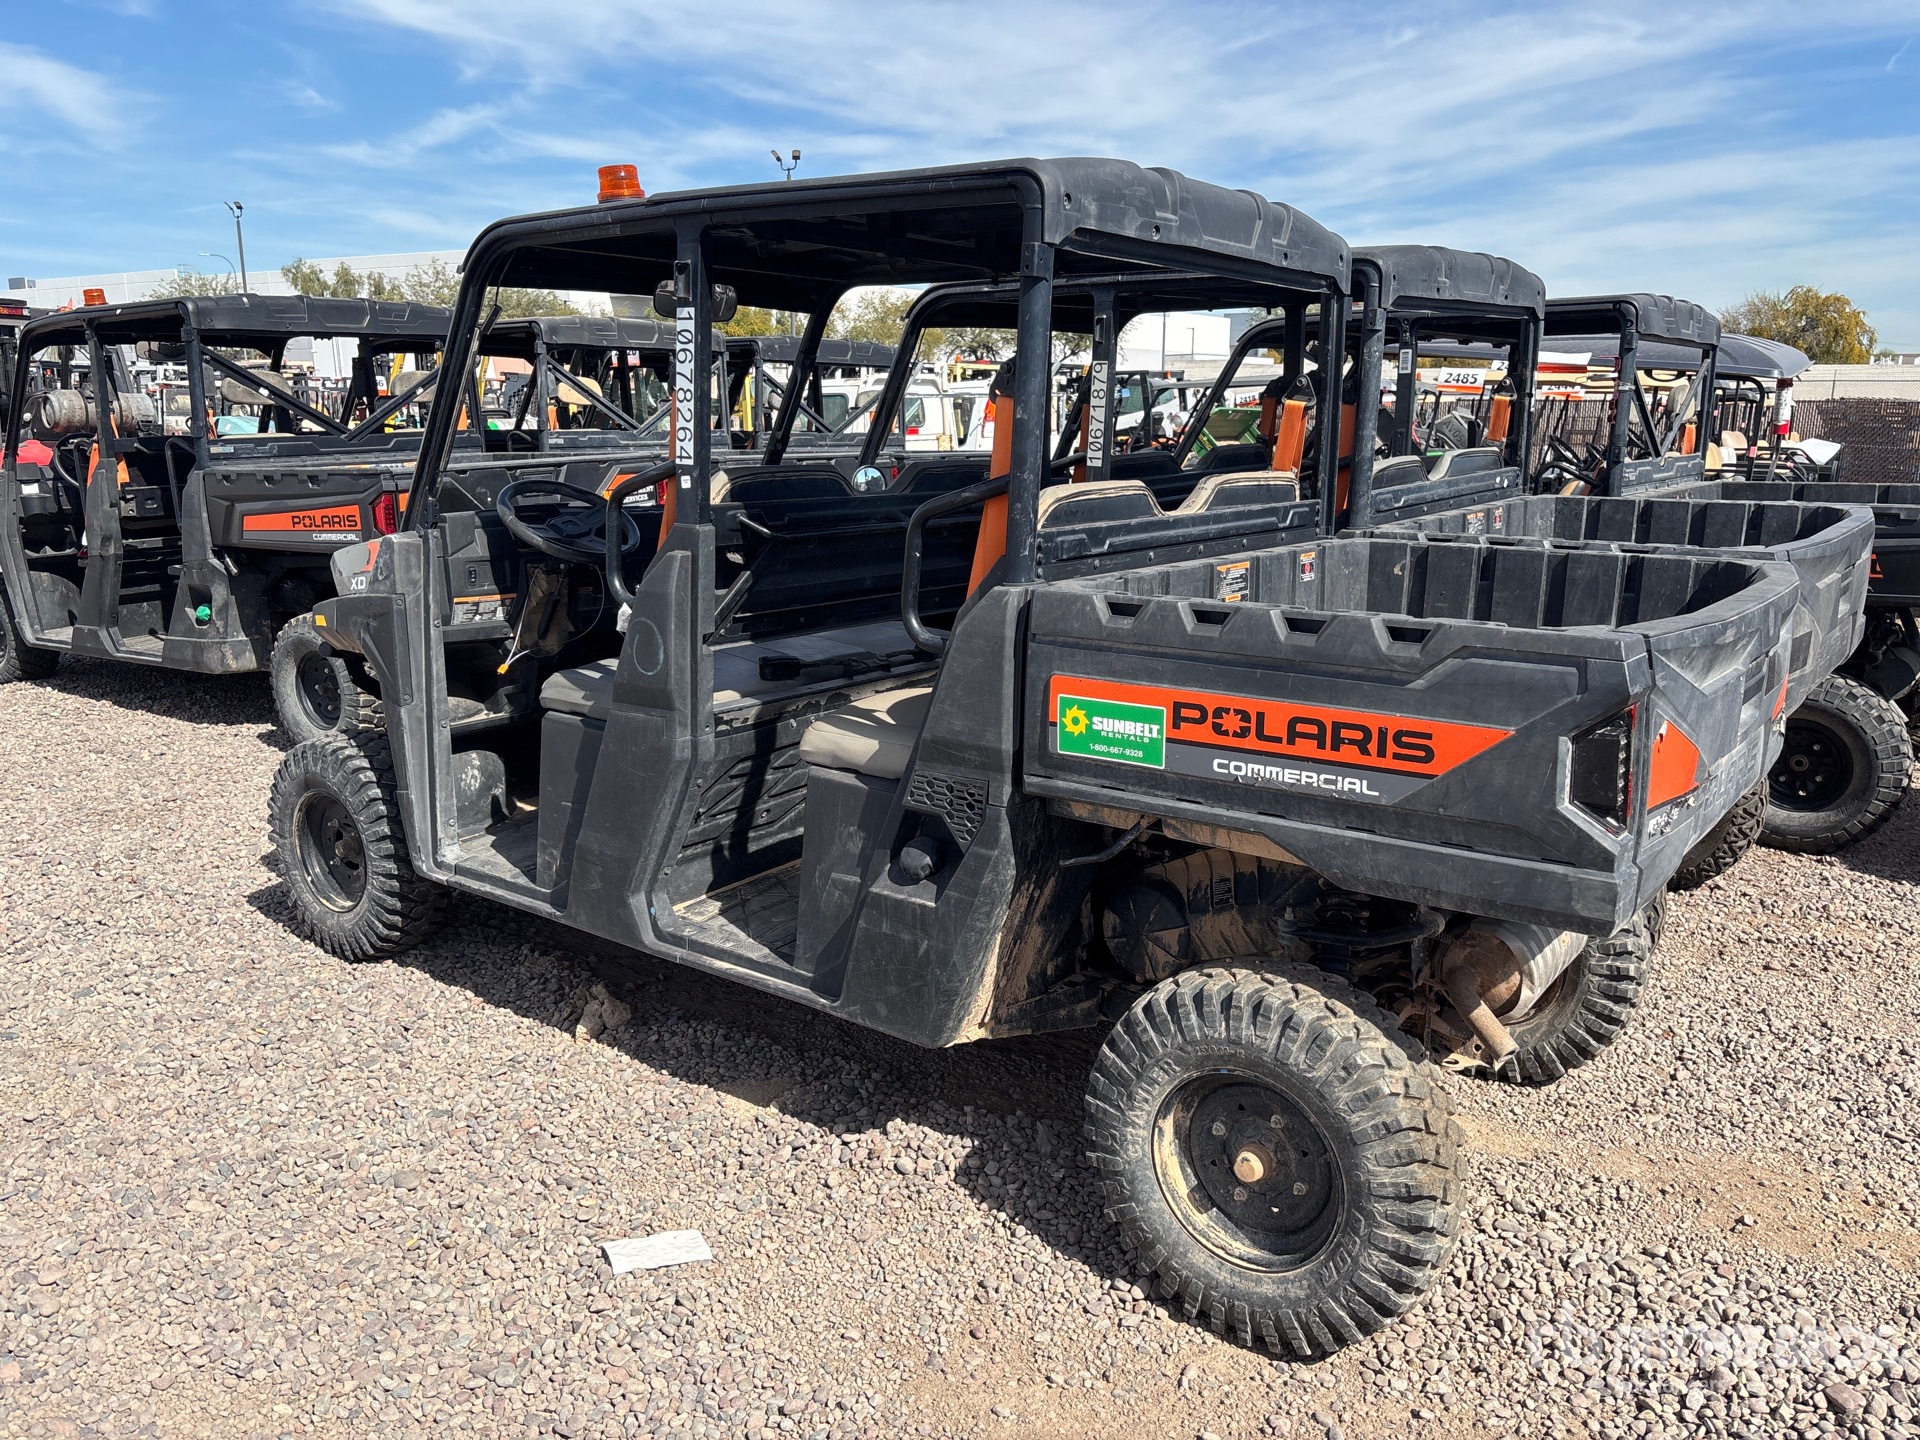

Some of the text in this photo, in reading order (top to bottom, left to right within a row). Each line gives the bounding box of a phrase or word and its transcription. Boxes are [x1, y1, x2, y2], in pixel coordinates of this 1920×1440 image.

[1443, 372, 1479, 385] 2485
[676, 311, 694, 463] 10678264
[1088, 362, 1108, 464] 10671879
[291, 514, 358, 529] POLARIS
[312, 533, 360, 541] COMMERCIAL
[350, 576, 366, 590] XD
[1092, 716, 1161, 739] SUNBELT
[1172, 700, 1436, 765] POLARIS
[1100, 731, 1150, 743] RENTALS
[1089, 743, 1144, 758] 1-800-667-9328
[1212, 758, 1380, 797] COMMERCIAL
